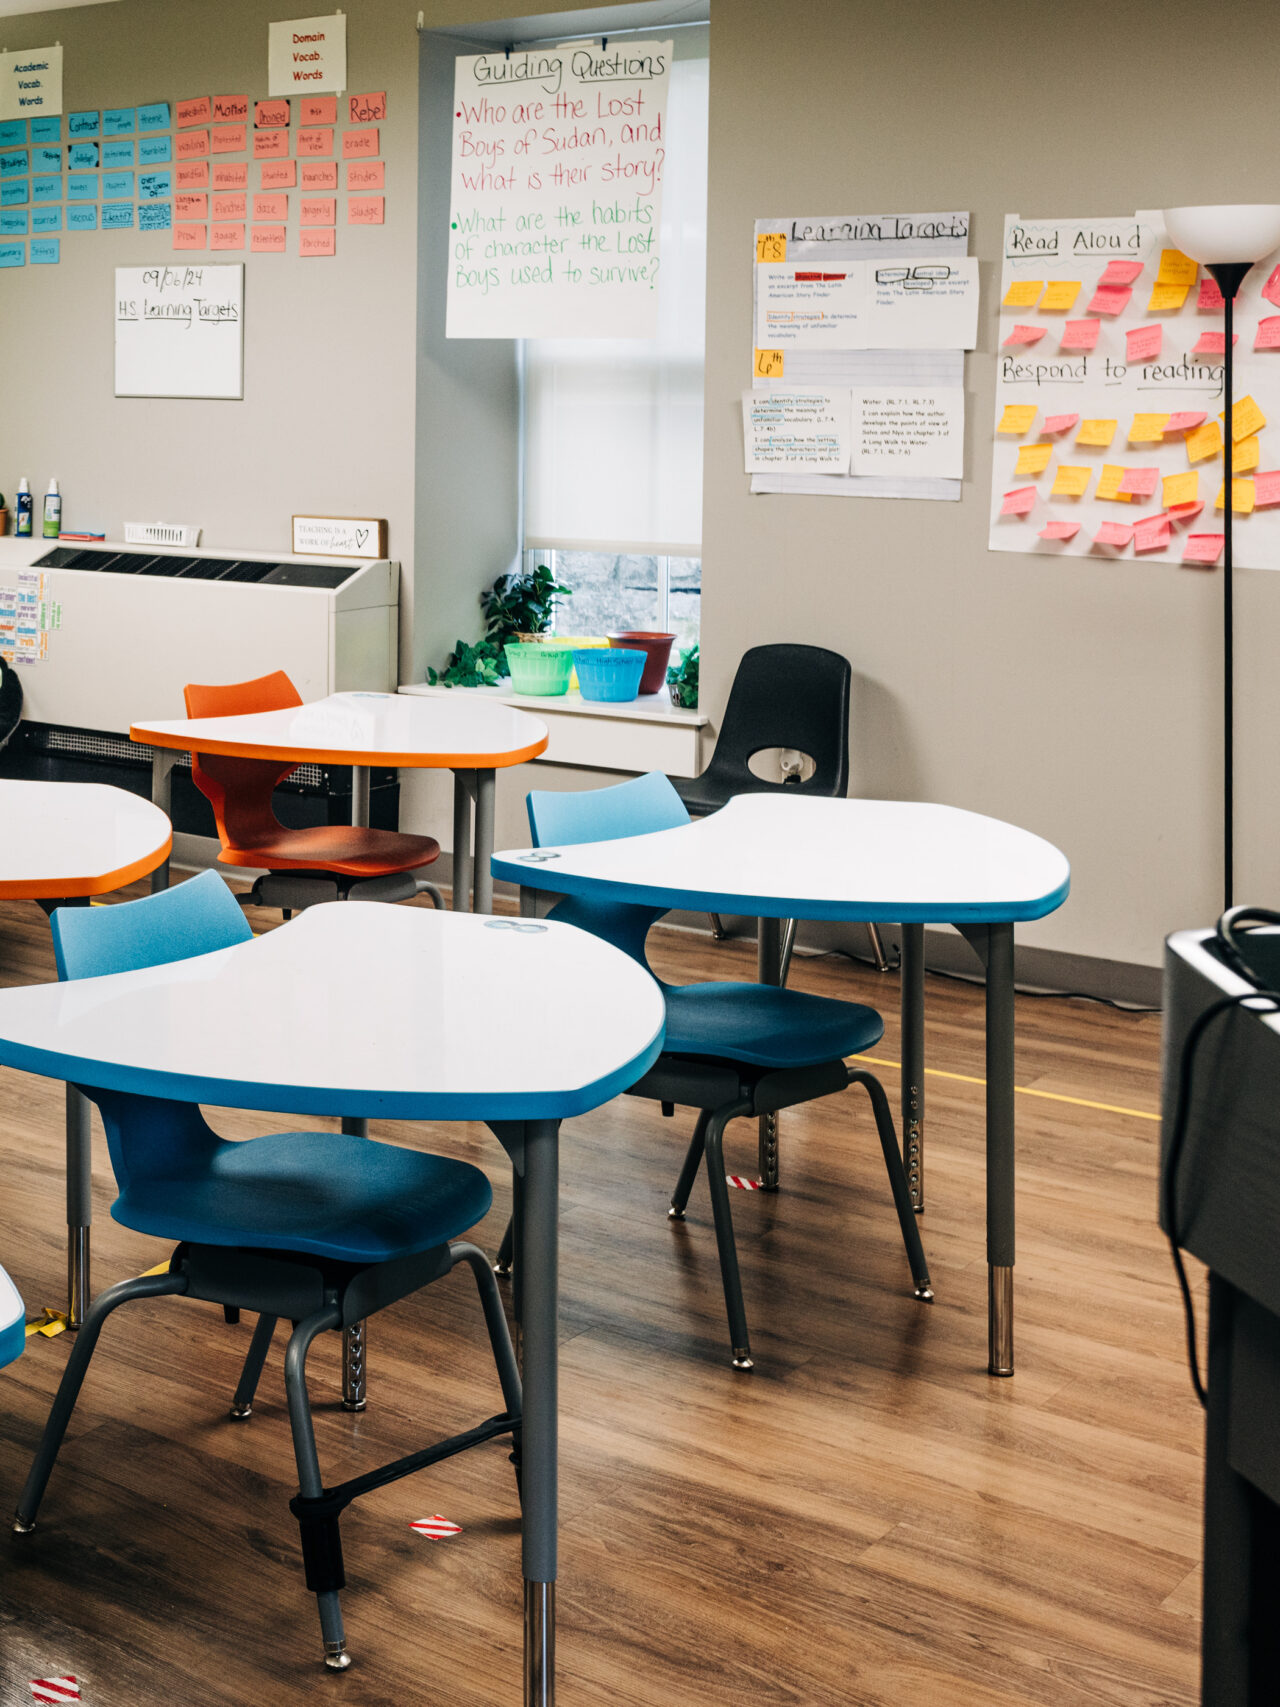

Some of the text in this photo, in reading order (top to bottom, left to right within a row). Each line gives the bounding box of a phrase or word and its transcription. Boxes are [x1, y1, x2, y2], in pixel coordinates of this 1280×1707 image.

[292, 33, 325, 44] Domain
[14, 62, 49, 72] Academic
[293, 52, 323, 62] Vocab.
[293, 71, 323, 81] Words
[474, 50, 665, 94] Guiding Questions
[18, 81, 42, 89] Vocab.
[19, 96, 43, 106] Words
[350, 96, 385, 122] Rebel
[462, 89, 645, 125] Who are the Lost
[459, 112, 661, 169] Boys of Sudan, and
[528, 168, 542, 190] is
[550, 164, 592, 188] their
[602, 149, 666, 196] story?
[457, 196, 653, 233] What are the habits
[792, 216, 968, 241] Learning Targets
[1012, 225, 1141, 250] Read Aloud
[456, 227, 656, 260] of character the Lost
[142, 267, 203, 292] 09/06/24
[456, 256, 660, 295] Boys used to survive?
[120, 298, 238, 329] HS Learning Targets
[1003, 354, 1225, 400] Respond to reading
[299, 525, 332, 533] TEACHING
[330, 537, 353, 550] heart
